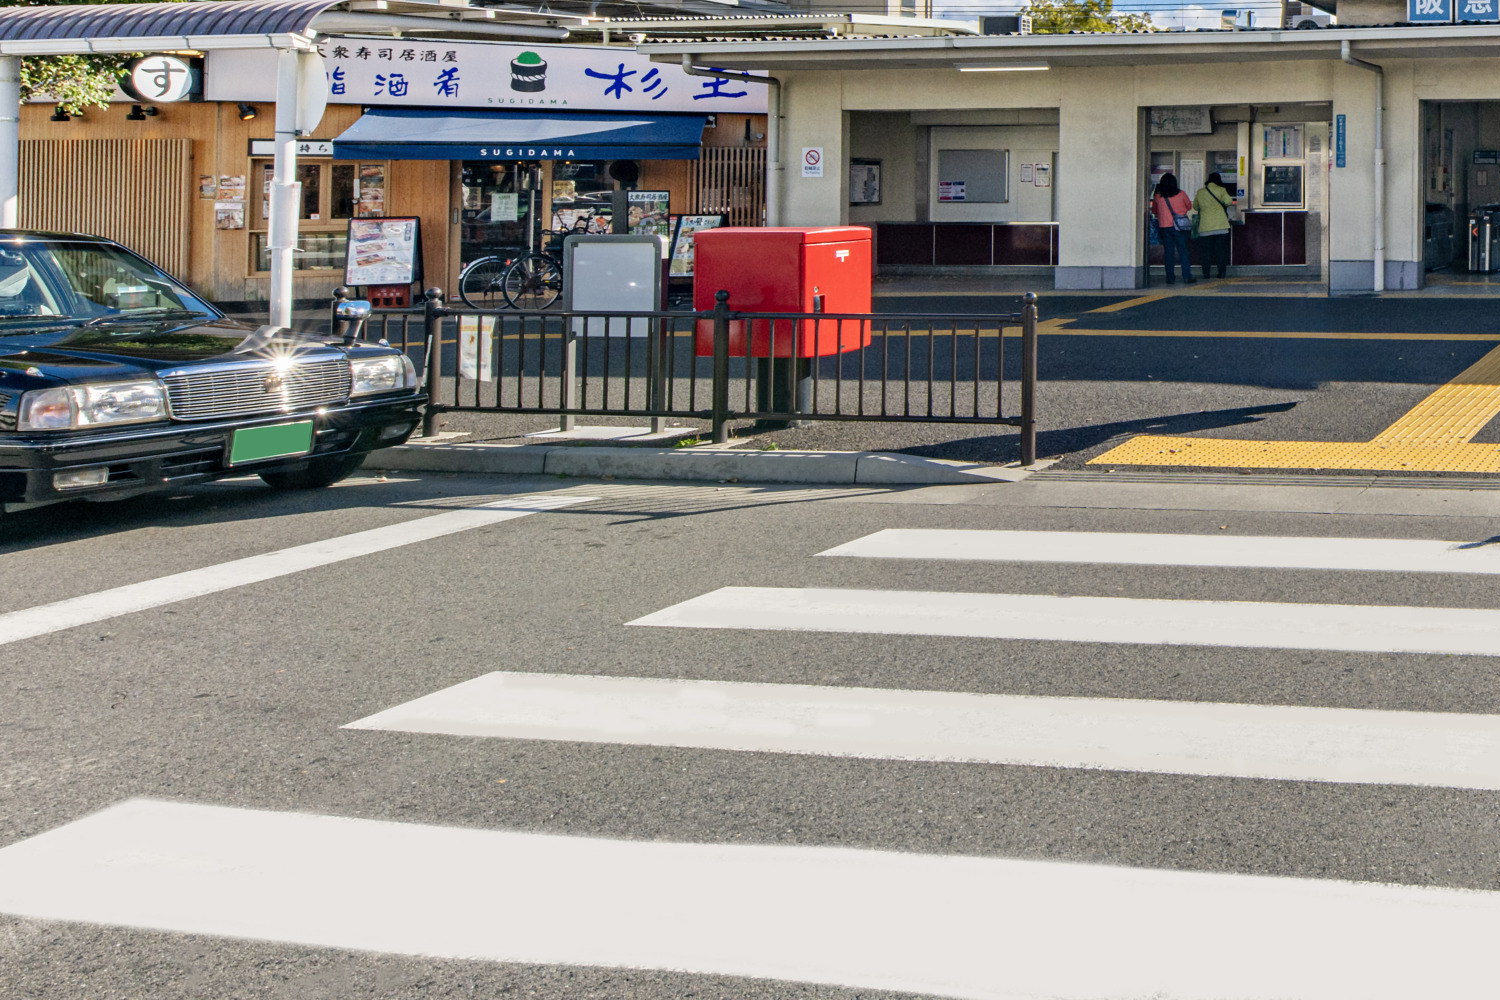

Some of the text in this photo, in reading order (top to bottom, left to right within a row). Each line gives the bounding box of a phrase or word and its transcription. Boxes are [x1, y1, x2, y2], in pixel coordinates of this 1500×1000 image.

[141, 60, 186, 98] す
[487, 97, 568, 105] SUGIDAMA
[480, 149, 575, 157] SUGIDAMA
